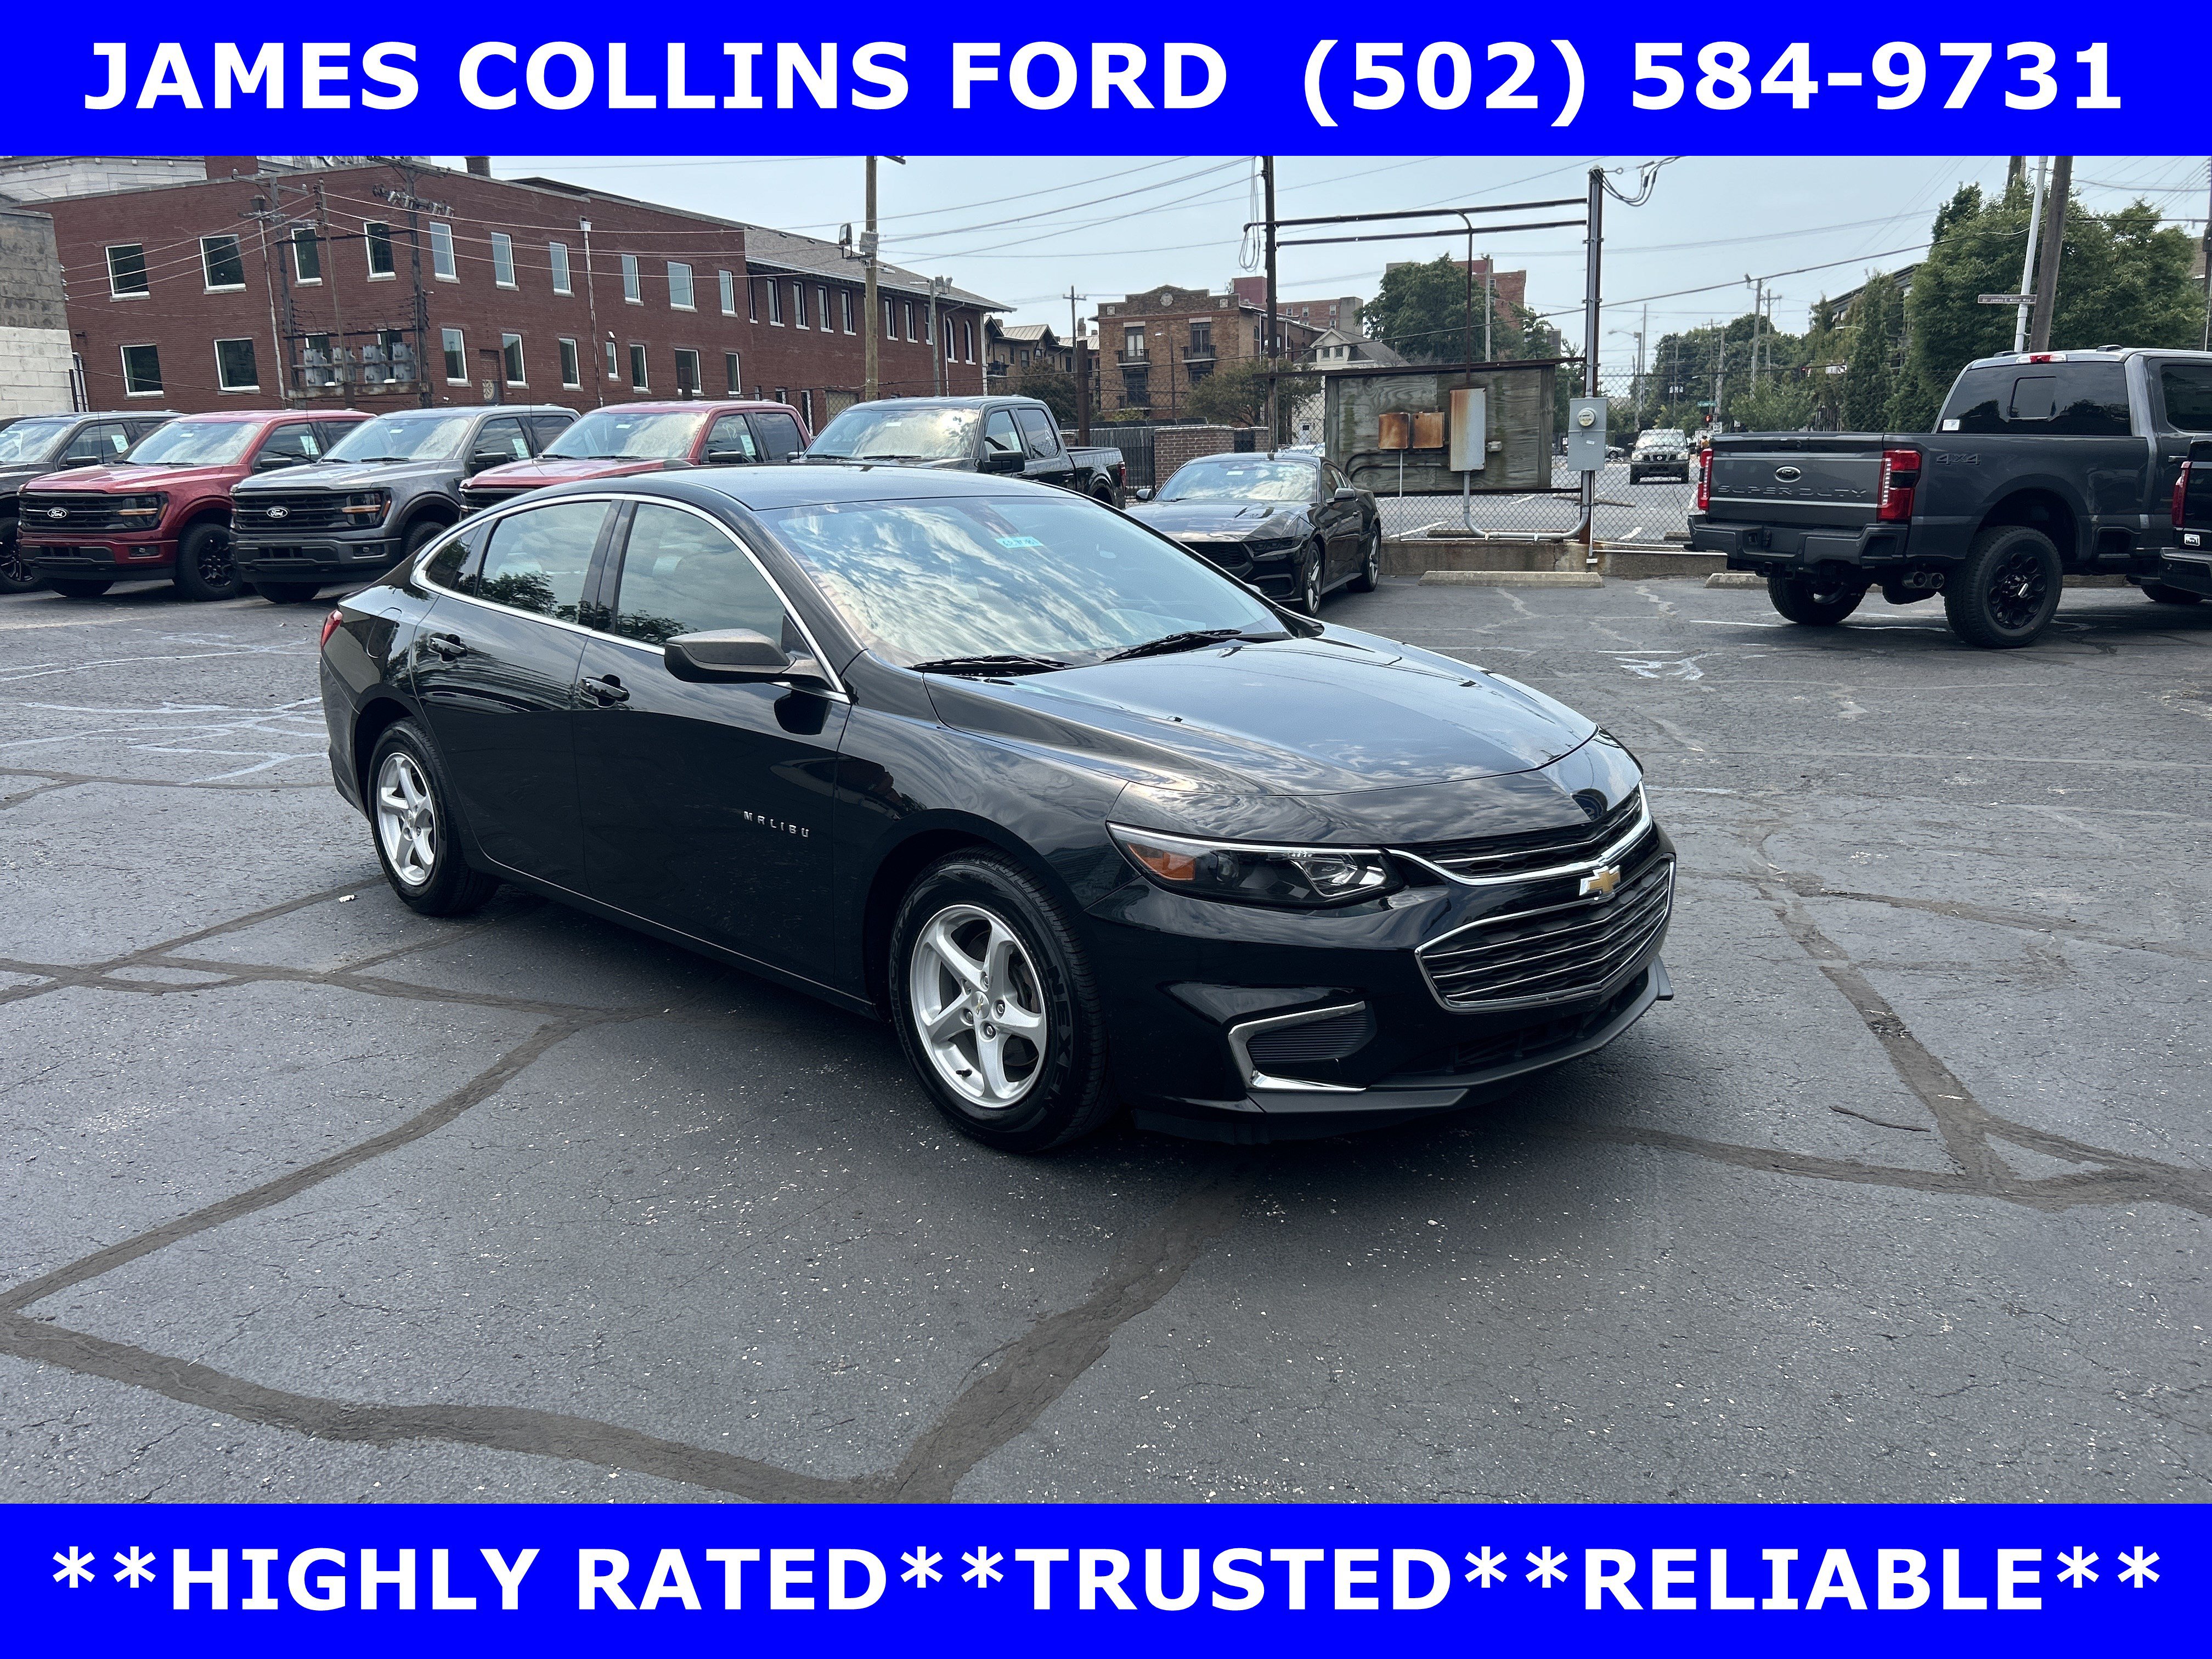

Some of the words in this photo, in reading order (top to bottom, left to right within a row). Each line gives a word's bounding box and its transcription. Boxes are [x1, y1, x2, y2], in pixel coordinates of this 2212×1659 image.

[1718, 486, 1793, 495] SUPER
[1799, 487, 1867, 498] DUTY
[744, 811, 809, 838] MALIBU
[1043, 965, 1070, 1109] NEXEN
